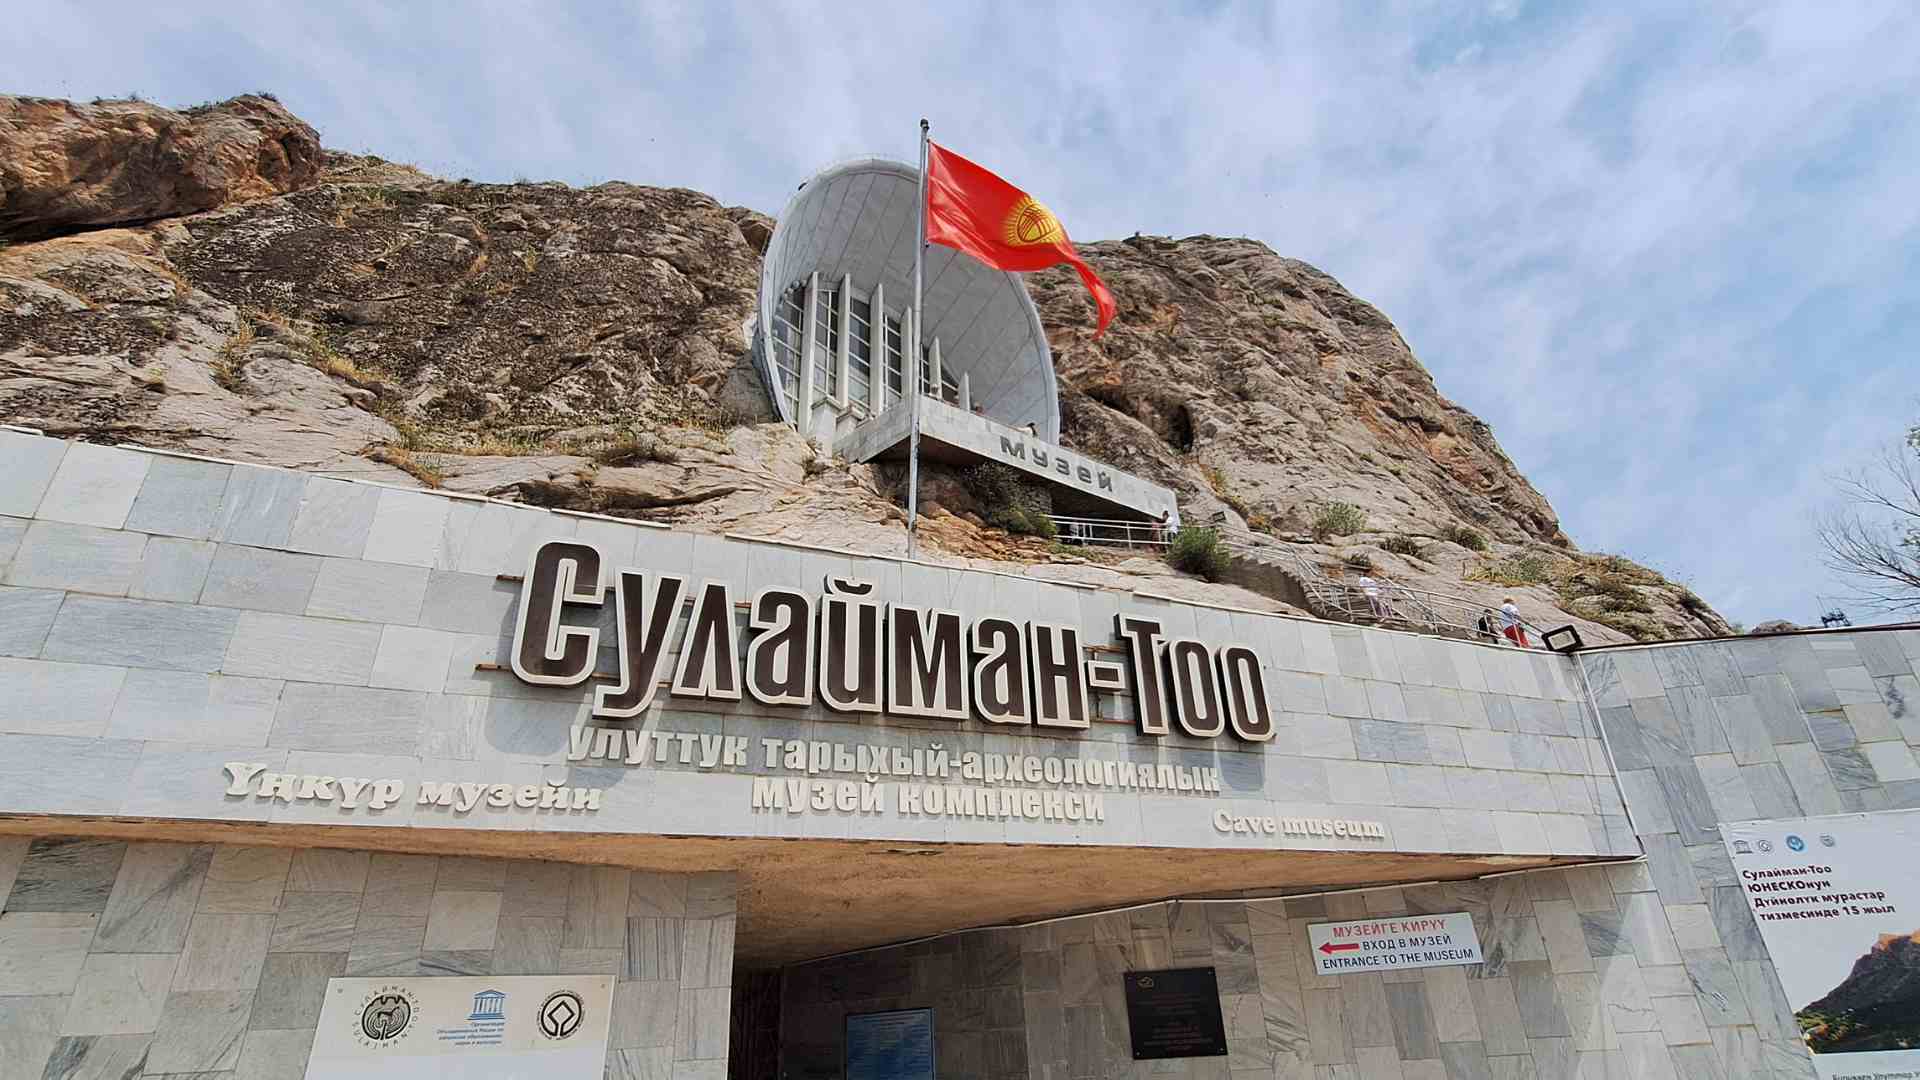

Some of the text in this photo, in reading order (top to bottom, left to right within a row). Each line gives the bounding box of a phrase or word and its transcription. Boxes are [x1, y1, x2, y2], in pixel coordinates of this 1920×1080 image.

[511, 541, 1275, 742] Сулайман-Тоо
[567, 725, 1221, 792] улуттук тарыхый-археологиялык
[416, 776, 601, 812] музейи
[752, 774, 1105, 821] музей комплекси
[1214, 809, 1385, 838] Cave museum
[1742, 865, 1832, 881] Сулайман-Тоо
[1748, 880, 1831, 893] ЮНЕСКОнун
[1822, 891, 1886, 904] мурастар
[1760, 904, 1896, 921] тизмесинде 15 жыл
[1333, 921, 1399, 939] МУЗЕЙГЕ
[1362, 933, 1452, 952] ВХОД В МУЗЕЙ
[1323, 948, 1474, 970] ENTRANCE TO THE MUSEUM
